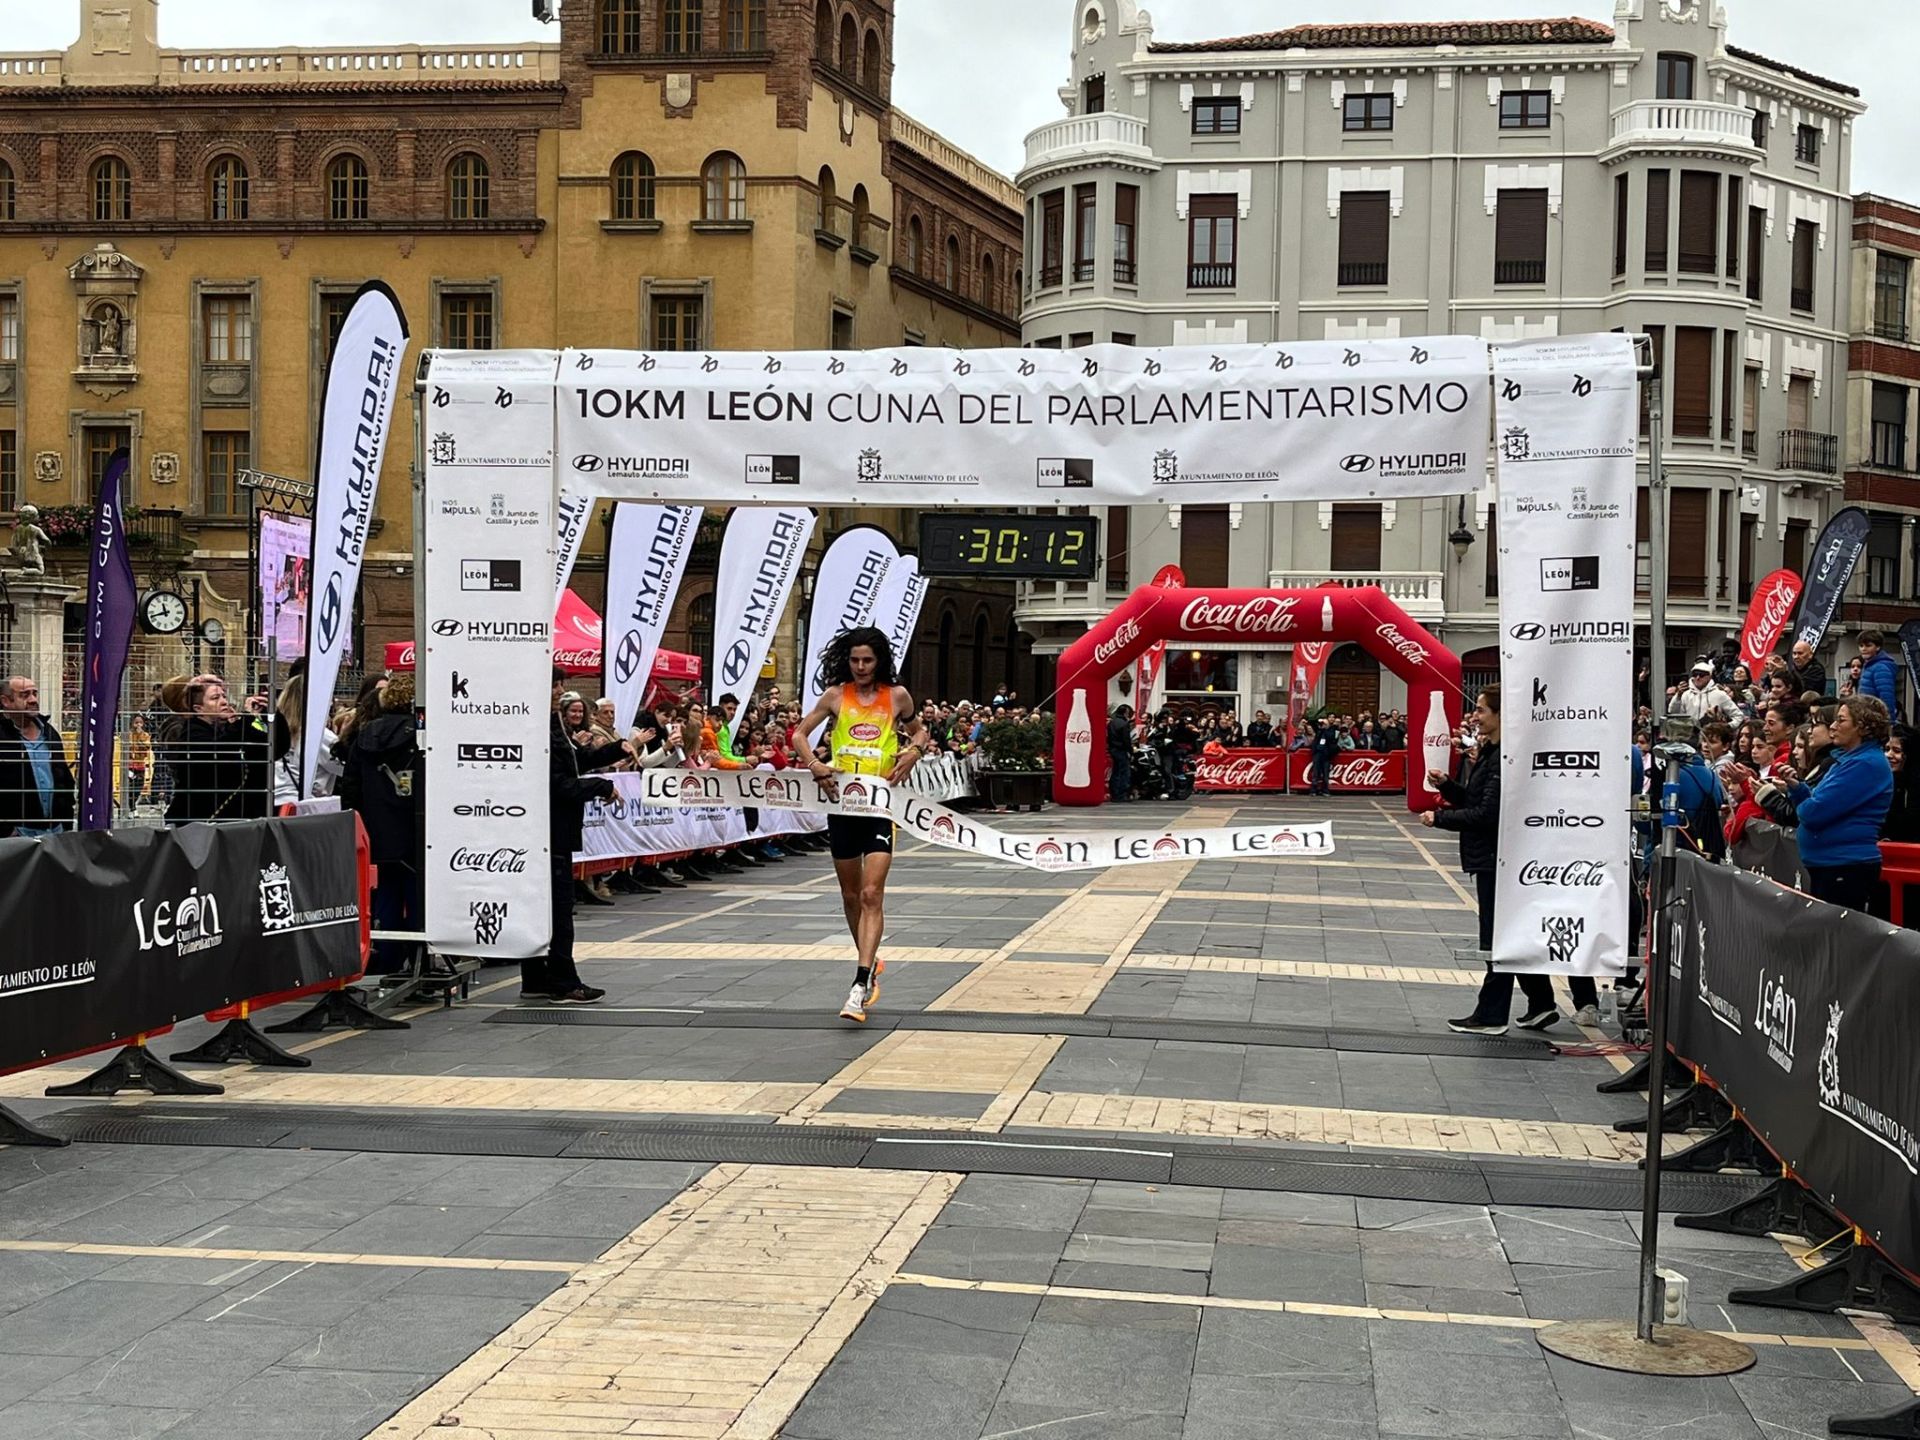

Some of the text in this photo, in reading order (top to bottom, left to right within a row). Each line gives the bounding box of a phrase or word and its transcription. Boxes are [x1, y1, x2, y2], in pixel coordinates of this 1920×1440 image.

[576, 382, 1468, 426] 10KM LEÓN CUNA DEL PARLAMENTARISMO
[336, 336, 389, 564] HYUNDAI
[347, 345, 396, 567] Lemauto Automoción
[531, 456, 551, 465] LEÓN
[1380, 453, 1466, 470] HYUNDAI
[1532, 446, 1633, 458] AYUNTAMIENTO DE LEÓN
[608, 456, 689, 472] HYUNDAI
[749, 464, 771, 474] LEÓN
[1041, 467, 1062, 477] LEÓN
[1380, 467, 1466, 477] Lemauto Automoción
[958, 473, 979, 482] LEÓN
[1180, 473, 1243, 481] AYUNTAMIENTO
[1257, 471, 1279, 479] LEÓN
[520, 517, 539, 525] León
[1567, 511, 1619, 521] Castilla y León
[99, 503, 114, 567] CLUB
[465, 569, 488, 579] LEÓN
[740, 512, 796, 635] HYUNDAI
[758, 518, 805, 637] Lemauto Automoción
[1545, 568, 1571, 579] LEÓN
[864, 556, 892, 615] Automoción
[649, 571, 673, 627] Lemauto
[1180, 596, 1301, 632] Coca-Cola
[1748, 578, 1798, 660] Coca-Cola
[468, 622, 548, 635] HYUNDAI
[1094, 616, 1142, 664] Coca-Cola
[1550, 622, 1629, 637] HYUNDAI
[1376, 623, 1430, 665] Coca-Cola
[451, 701, 530, 715] kutxabank
[1531, 705, 1608, 722] kutxabank
[460, 746, 521, 759] LEON
[1535, 754, 1598, 767] LEON
[648, 772, 724, 798] León
[737, 774, 802, 801] León
[453, 799, 526, 817] emico
[1524, 808, 1604, 828] emico
[904, 799, 976, 847] León
[1000, 837, 1088, 862] León
[1114, 833, 1206, 860] León
[1233, 828, 1325, 851] León
[449, 847, 529, 873] Coca-Cola
[1519, 859, 1608, 887] Coca-Cola
[133, 887, 223, 950] León
[52, 964, 69, 980] DE
[71, 957, 96, 978] LEÓN
[1754, 967, 1796, 1058] León
